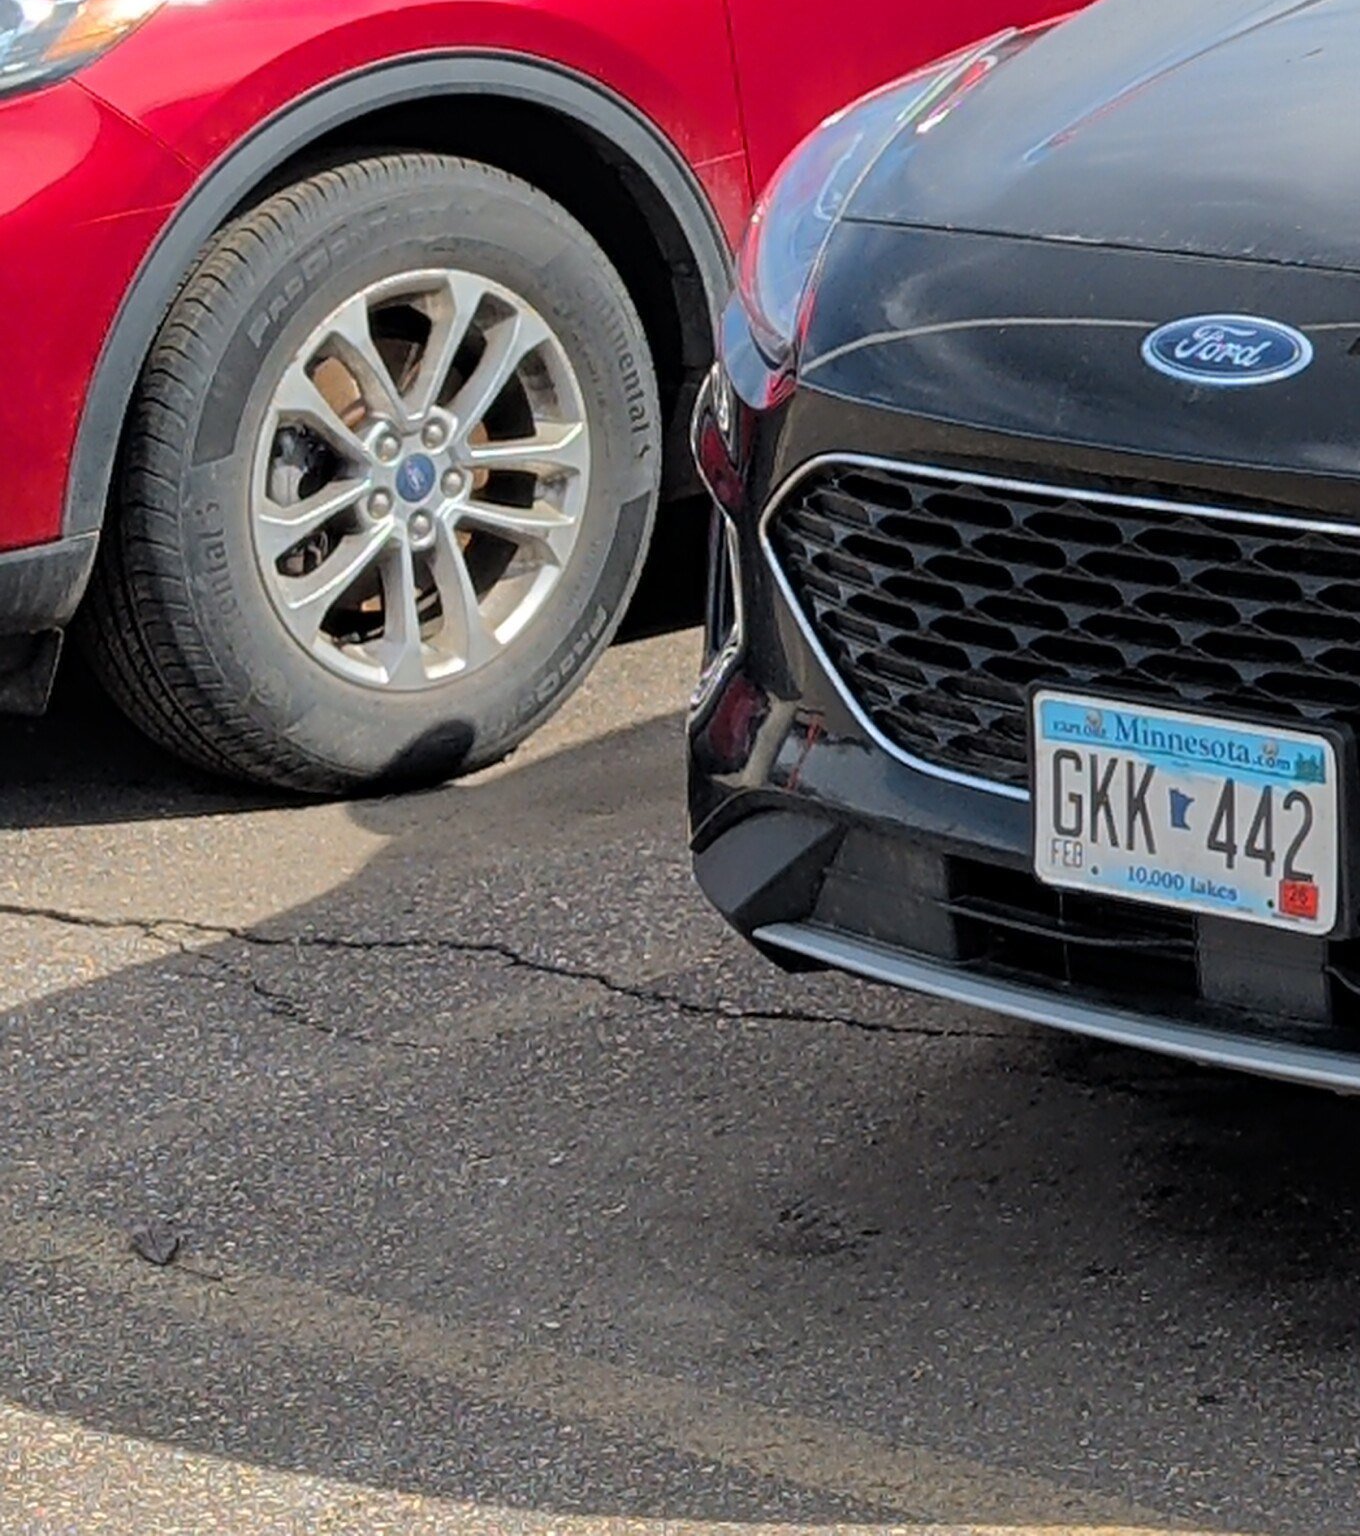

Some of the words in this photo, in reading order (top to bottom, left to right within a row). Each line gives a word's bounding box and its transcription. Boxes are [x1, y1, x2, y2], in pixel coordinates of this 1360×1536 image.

[1175, 324, 1272, 368] Ford
[1114, 713, 1250, 765] Minnesota
[1052, 748, 1157, 855] GKK
[1206, 777, 1314, 883] 442
[1051, 838, 1083, 869] FEB
